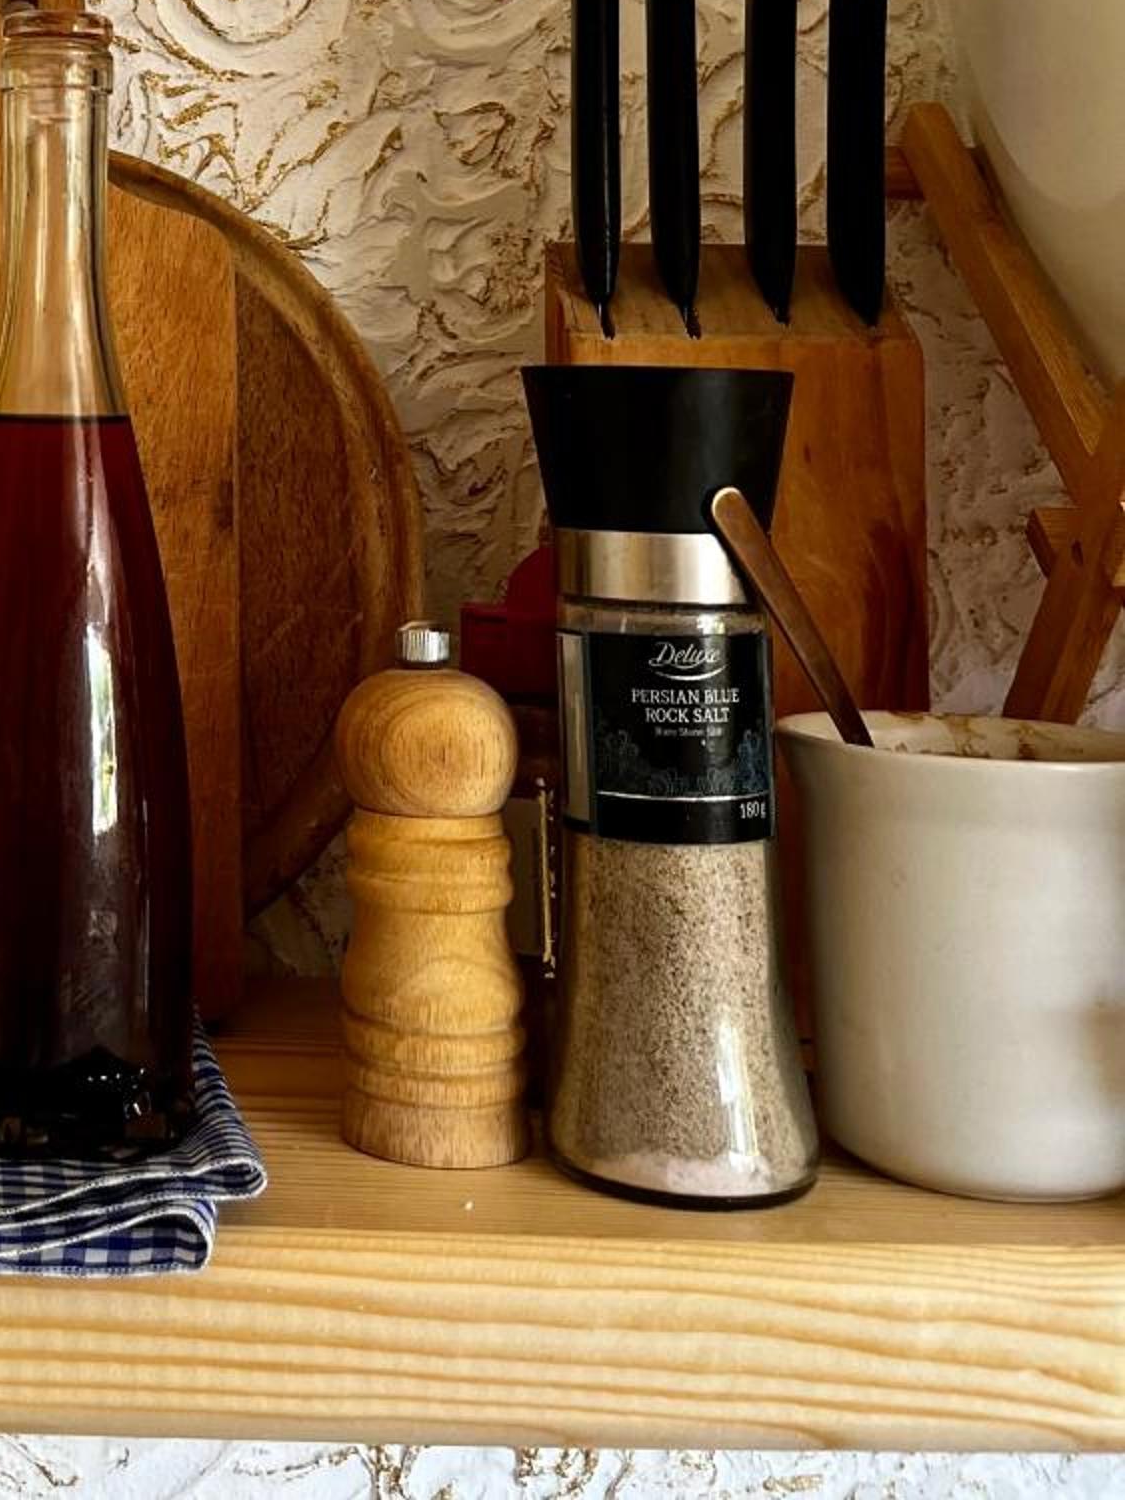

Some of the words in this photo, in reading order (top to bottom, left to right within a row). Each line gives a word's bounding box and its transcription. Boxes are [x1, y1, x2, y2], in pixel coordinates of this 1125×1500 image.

[648, 641, 721, 669] Deluxe
[632, 688, 700, 705] PERSIAN
[704, 687, 740, 704] BLUE
[645, 707, 690, 723] ROCK
[693, 707, 730, 723] SALT
